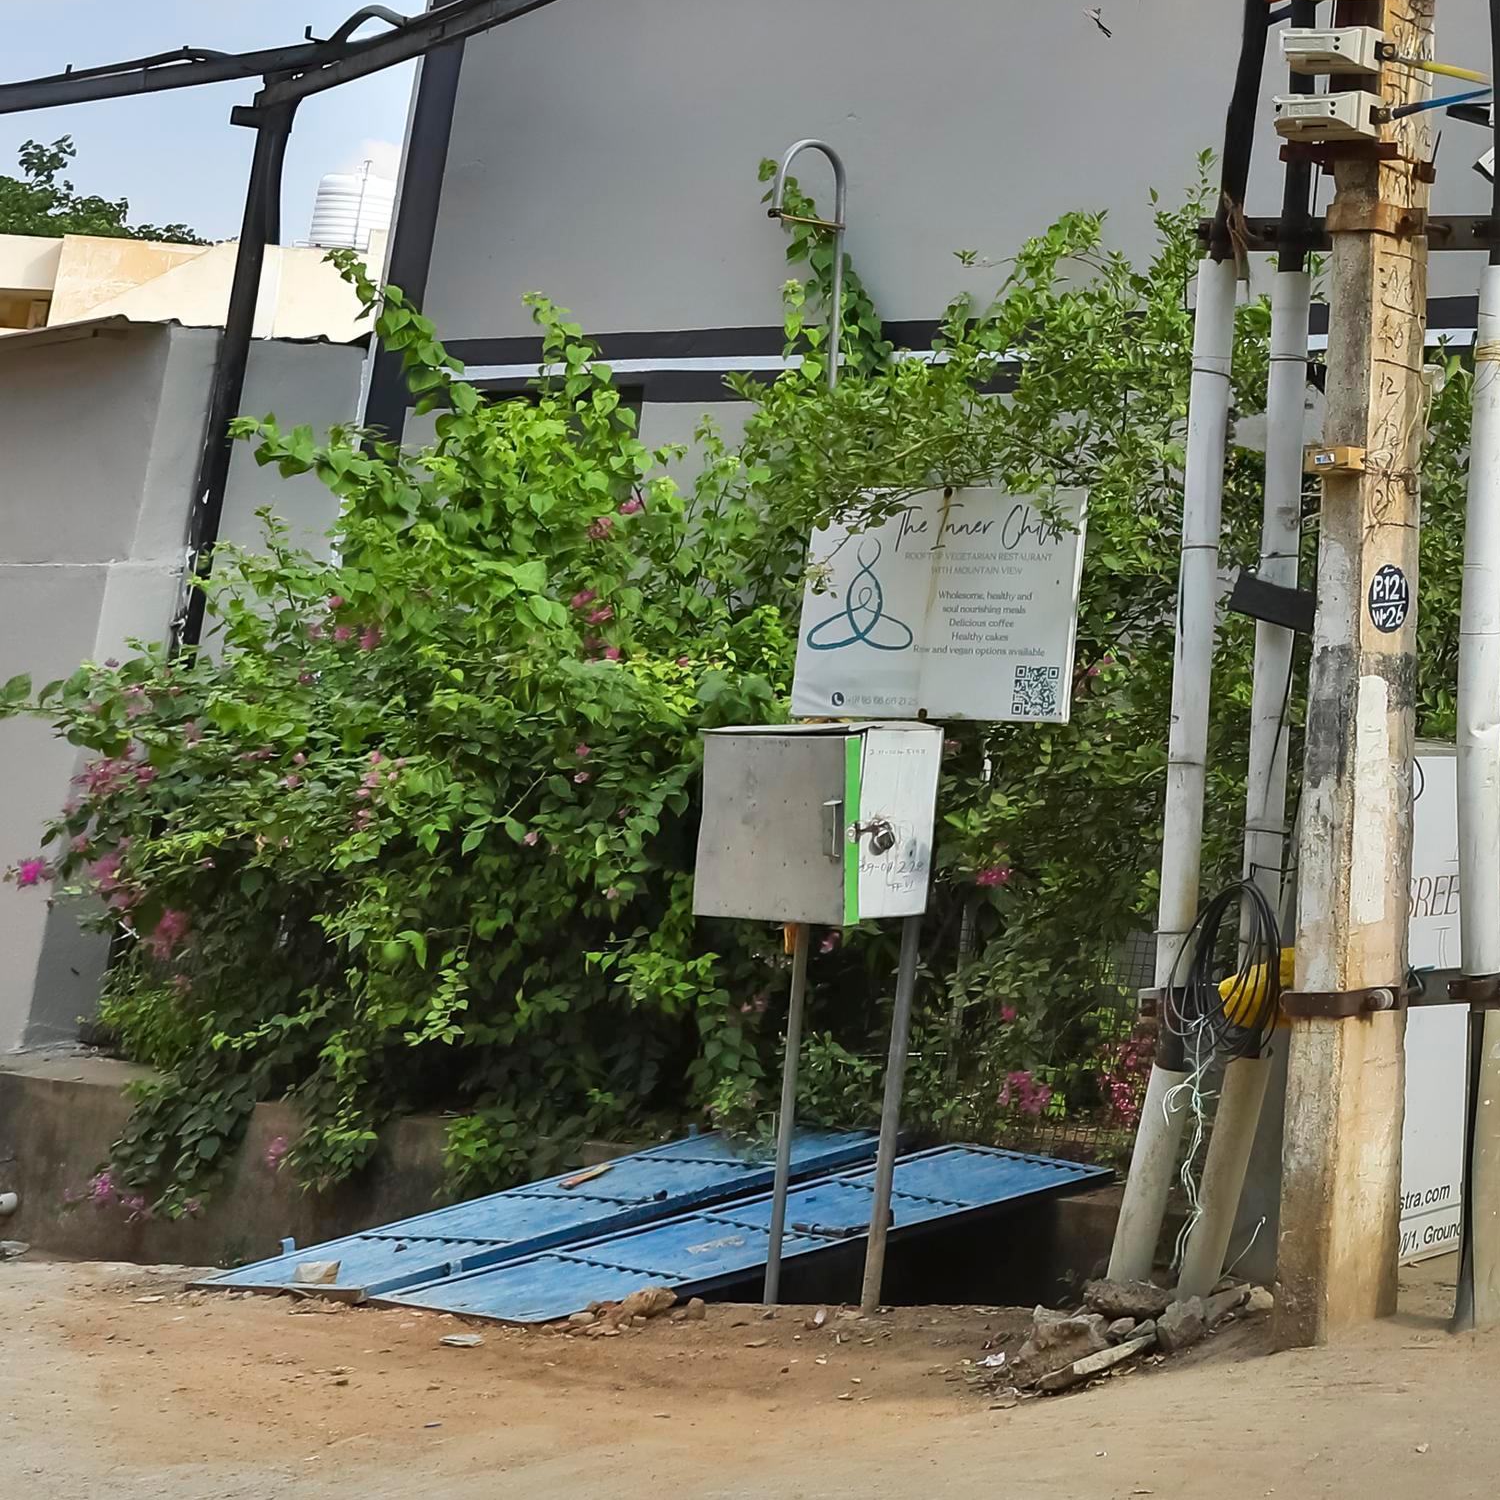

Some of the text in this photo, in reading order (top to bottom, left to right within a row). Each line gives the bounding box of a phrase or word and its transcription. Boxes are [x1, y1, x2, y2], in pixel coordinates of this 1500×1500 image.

[895, 505, 928, 551] The
[931, 504, 995, 550] Inner
[998, 552, 1053, 561] RESTAURANT
[1373, 574, 1406, 601] P.121
[987, 591, 1015, 602] healthy
[1017, 592, 1032, 600] and
[942, 605, 1026, 614] soul nourishing meals
[949, 618, 1014, 627] Delicious coffee
[951, 632, 983, 642] Healthy
[932, 645, 948, 653] and
[949, 647, 973, 656] vegan
[976, 647, 1006, 656] options
[1008, 648, 1045, 656] available
